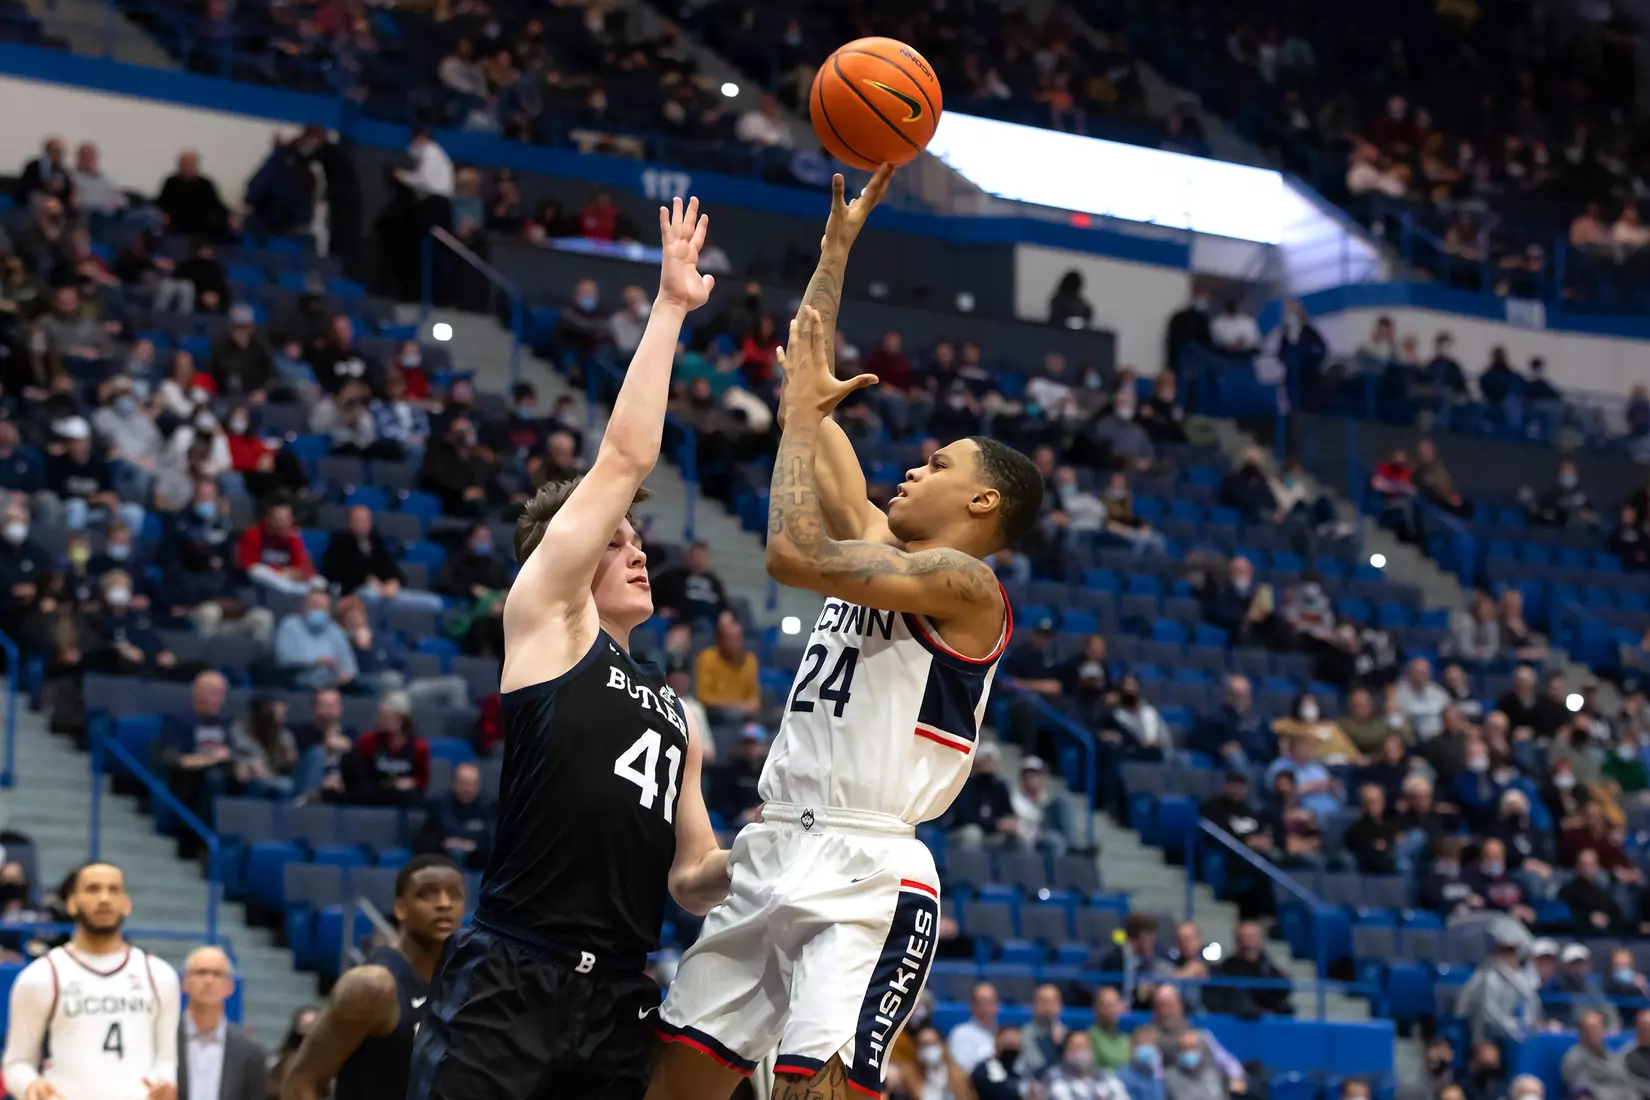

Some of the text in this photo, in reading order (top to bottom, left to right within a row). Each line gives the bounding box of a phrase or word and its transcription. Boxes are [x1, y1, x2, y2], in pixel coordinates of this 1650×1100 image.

[790, 643, 860, 718] 24
[613, 728, 682, 825] 41
[574, 950, 596, 974] B
[868, 908, 932, 1069] HUSKIES
[63, 996, 153, 1018] UCONN
[103, 1020, 124, 1060] 4
